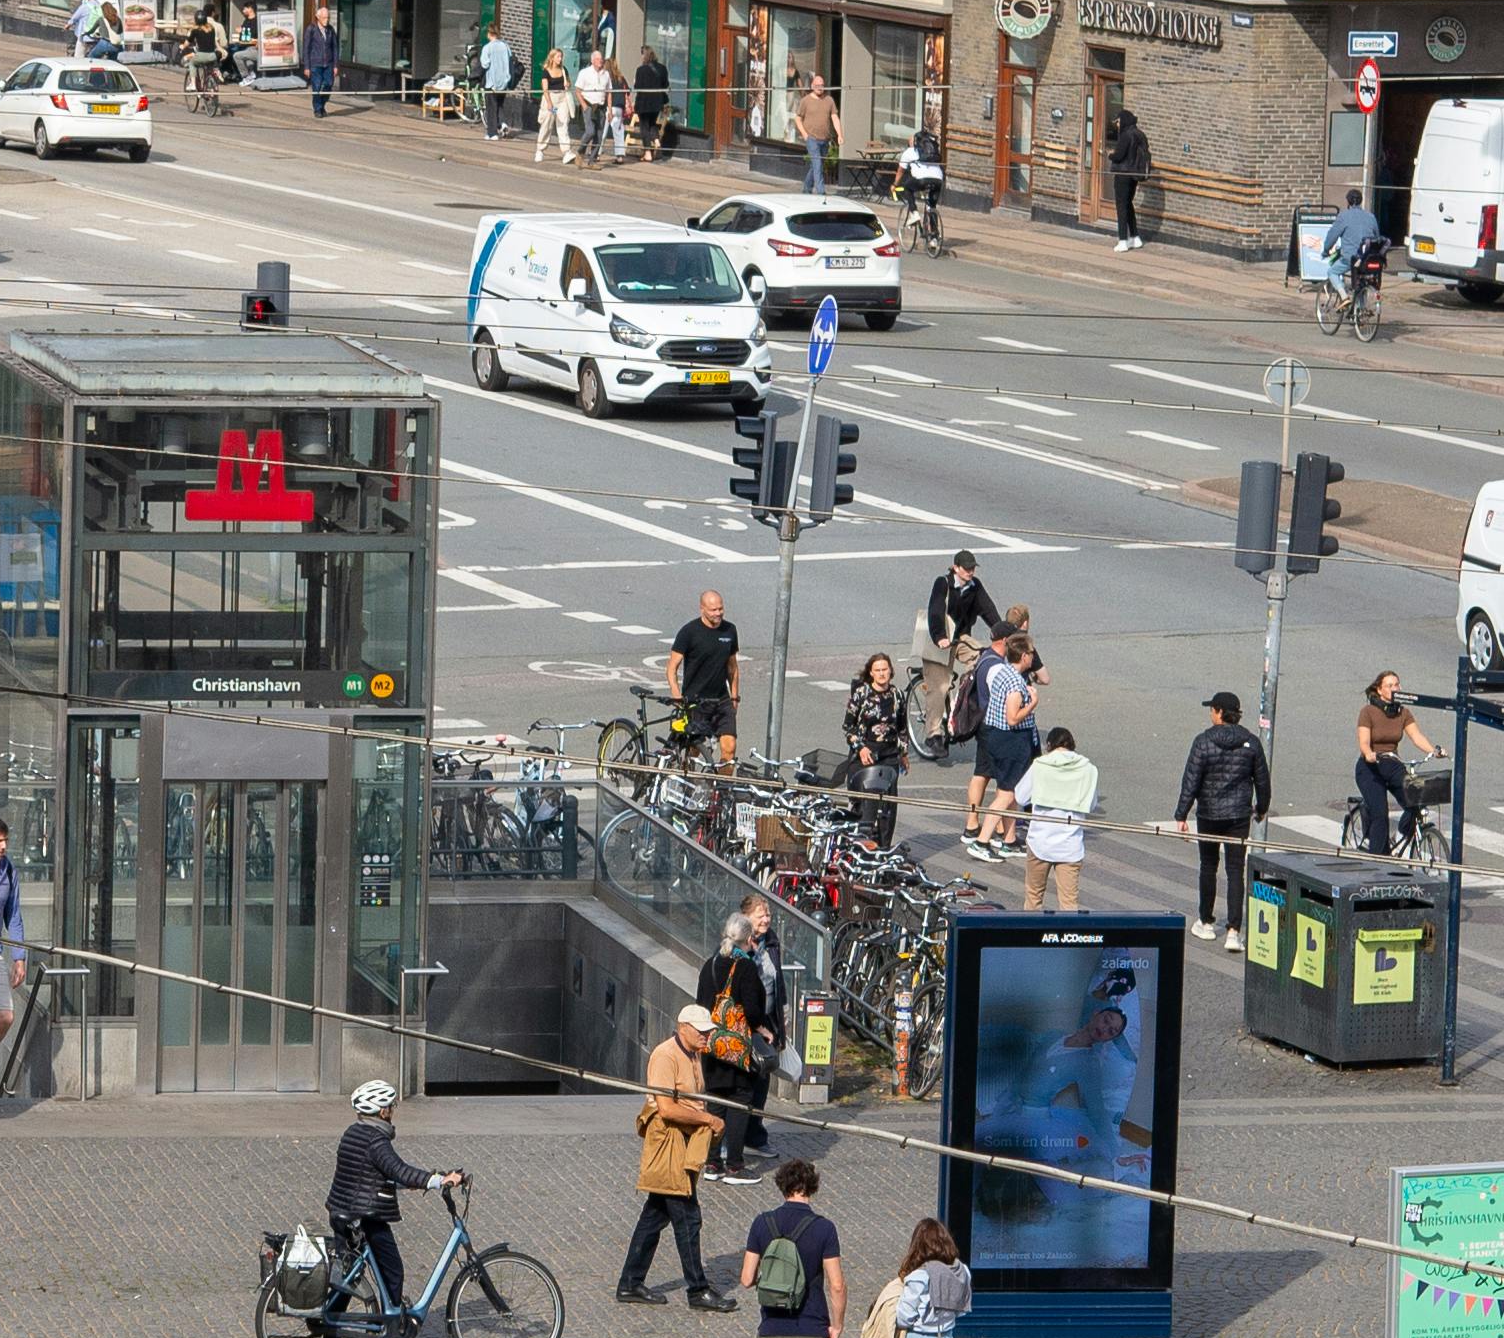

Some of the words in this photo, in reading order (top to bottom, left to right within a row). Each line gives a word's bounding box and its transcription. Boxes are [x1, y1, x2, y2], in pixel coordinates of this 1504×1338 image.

[1005, 16, 1047, 36] HOUSE
[1160, 9, 1221, 46] HOUSE
[1430, 19, 1464, 38] ESPRESSO
[1354, 40, 1385, 49] Ensrettet
[691, 373, 702, 382] CW
[703, 373, 712, 382] 73
[714, 373, 729, 382] 692
[192, 677, 301, 693] Christianshavn
[346, 680, 362, 690] M1
[373, 680, 390, 690] M2
[1042, 934, 1059, 943] AFA
[1061, 934, 1103, 943] JCDecaux
[1102, 957, 1149, 969] zalando
[984, 1136, 1012, 1147] Som
[1023, 1139, 1038, 1148] en
[1040, 1136, 1073, 1147] drøm
[1469, 1250, 1498, 1258] SANKT
[1441, 1325, 1464, 1333] ÅRETS
